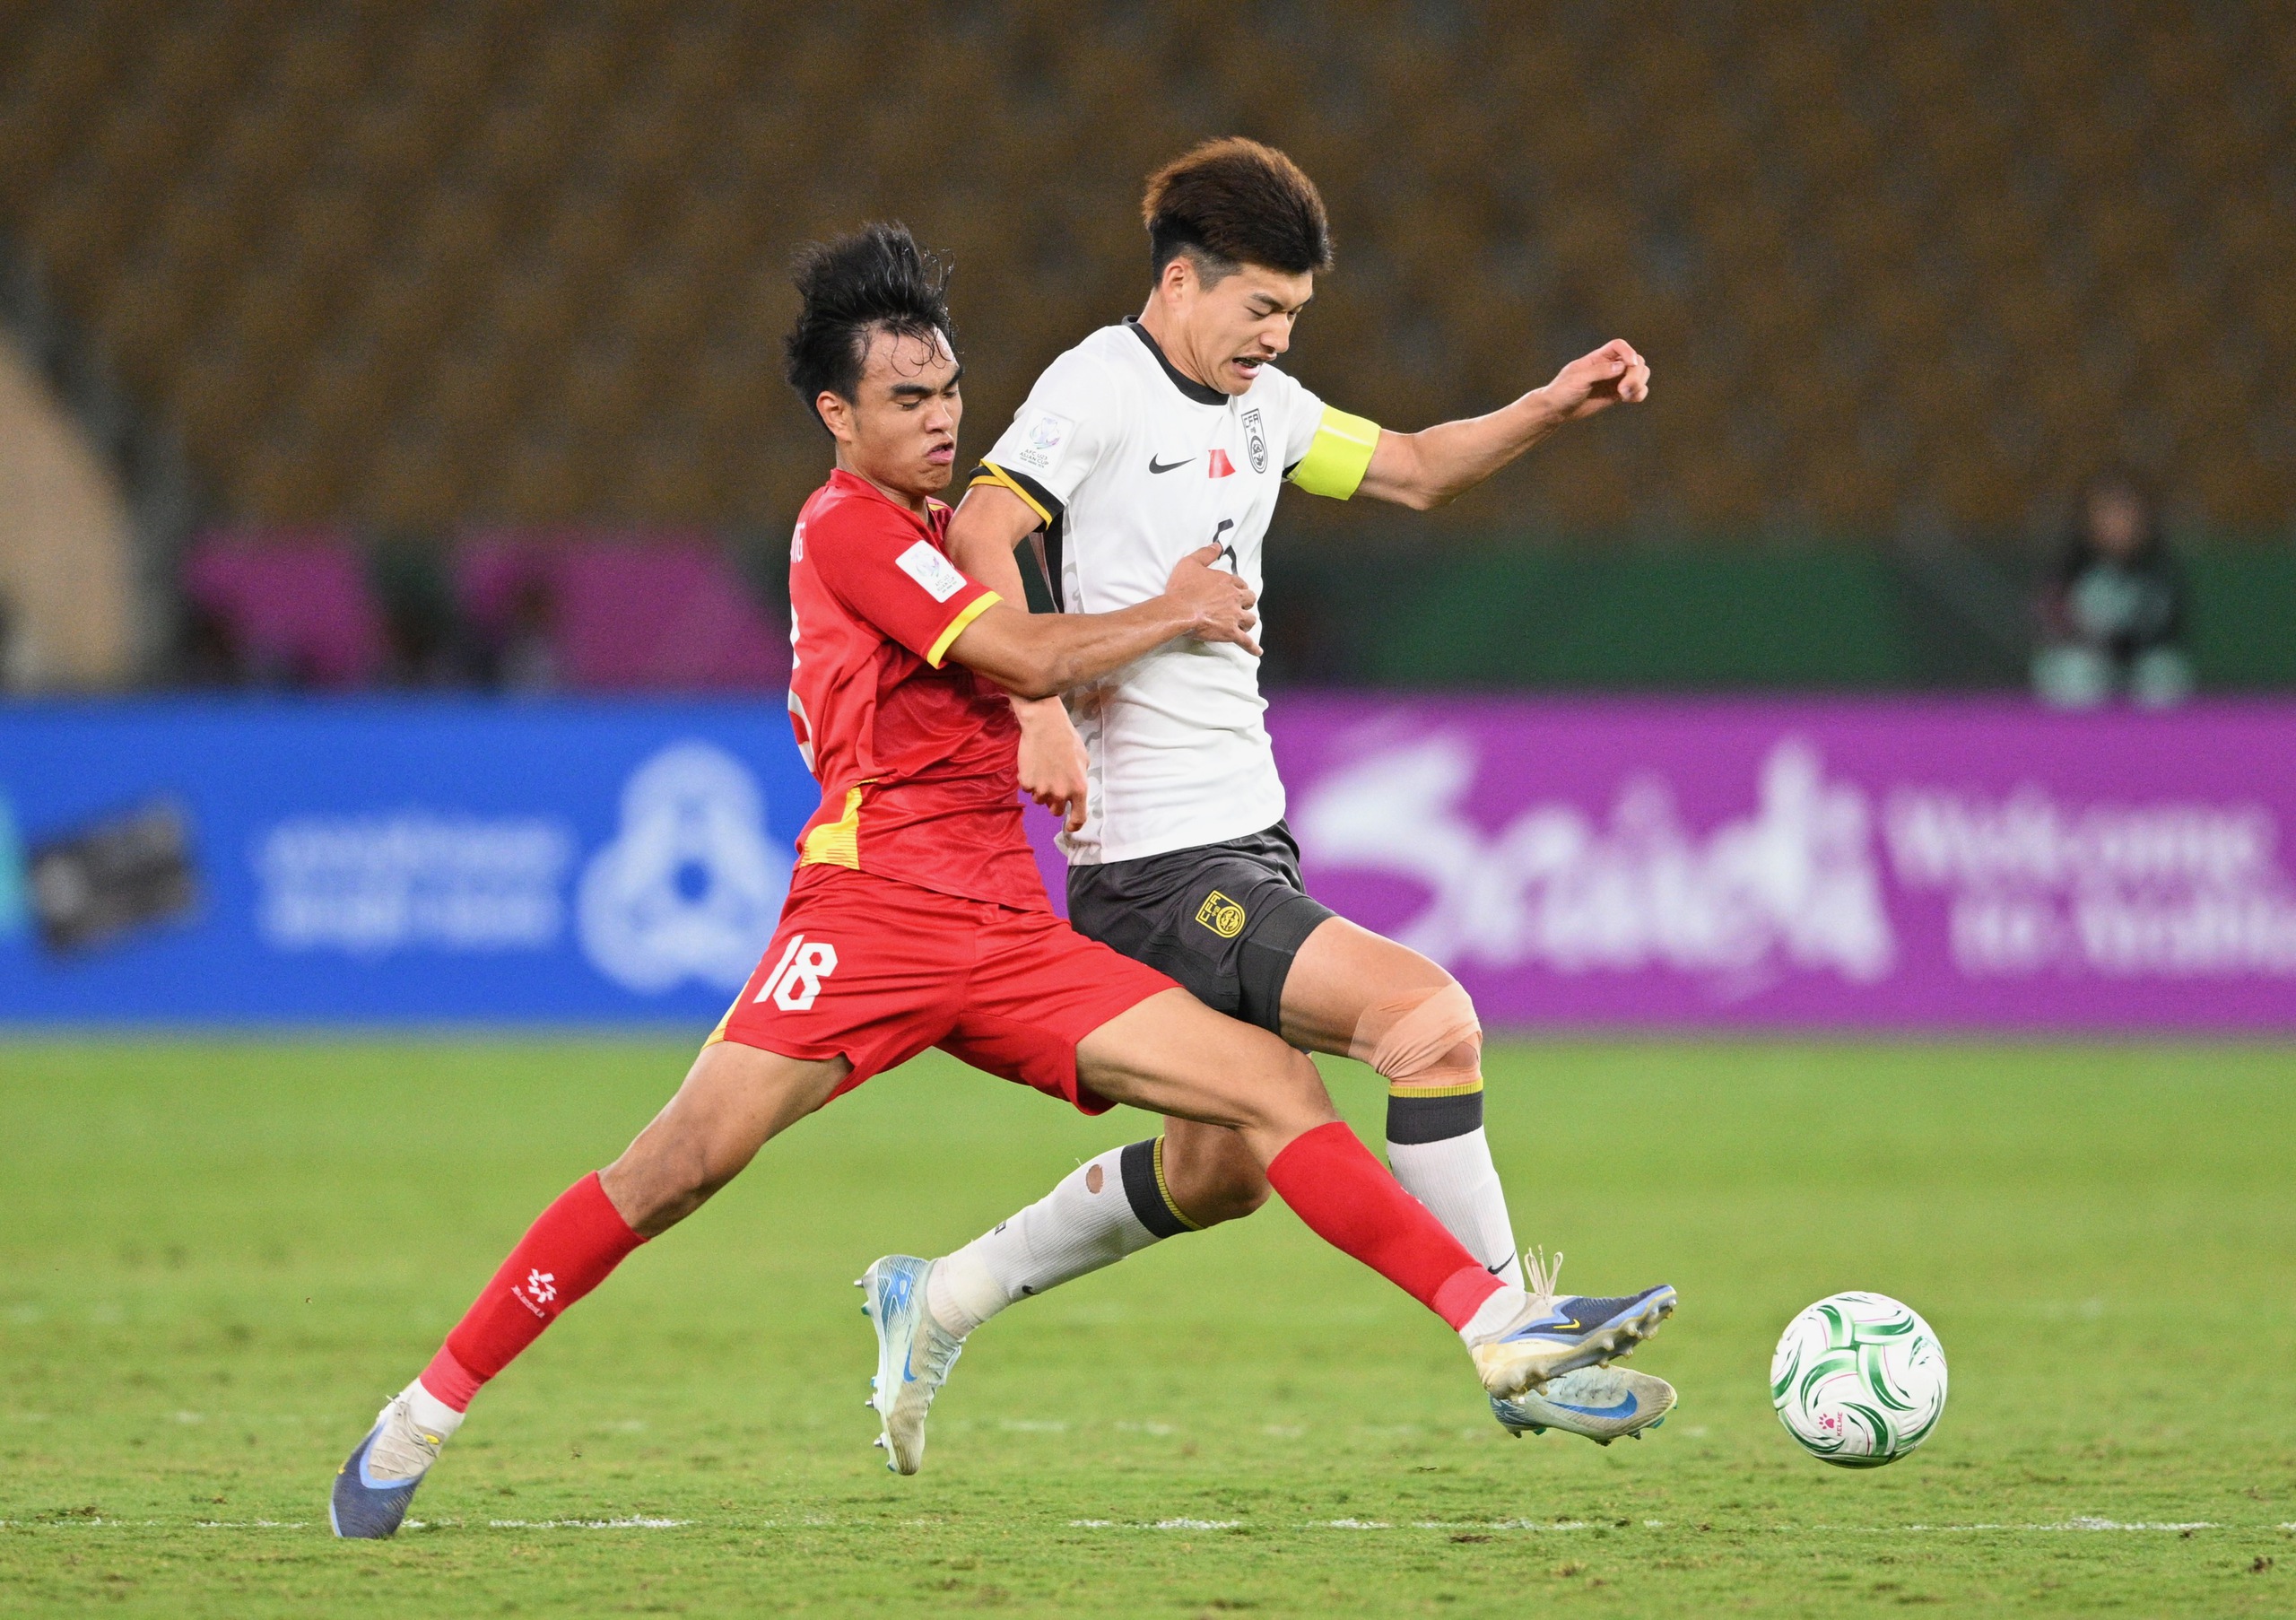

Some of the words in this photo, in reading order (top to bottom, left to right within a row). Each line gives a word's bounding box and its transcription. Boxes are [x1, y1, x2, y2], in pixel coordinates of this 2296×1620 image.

[1244, 414, 1260, 428] CFA
[1019, 451, 1037, 461] ASIAN
[1024, 449, 1037, 457] AFC
[1200, 894, 1222, 922] CFA
[752, 935, 838, 1011] 18
